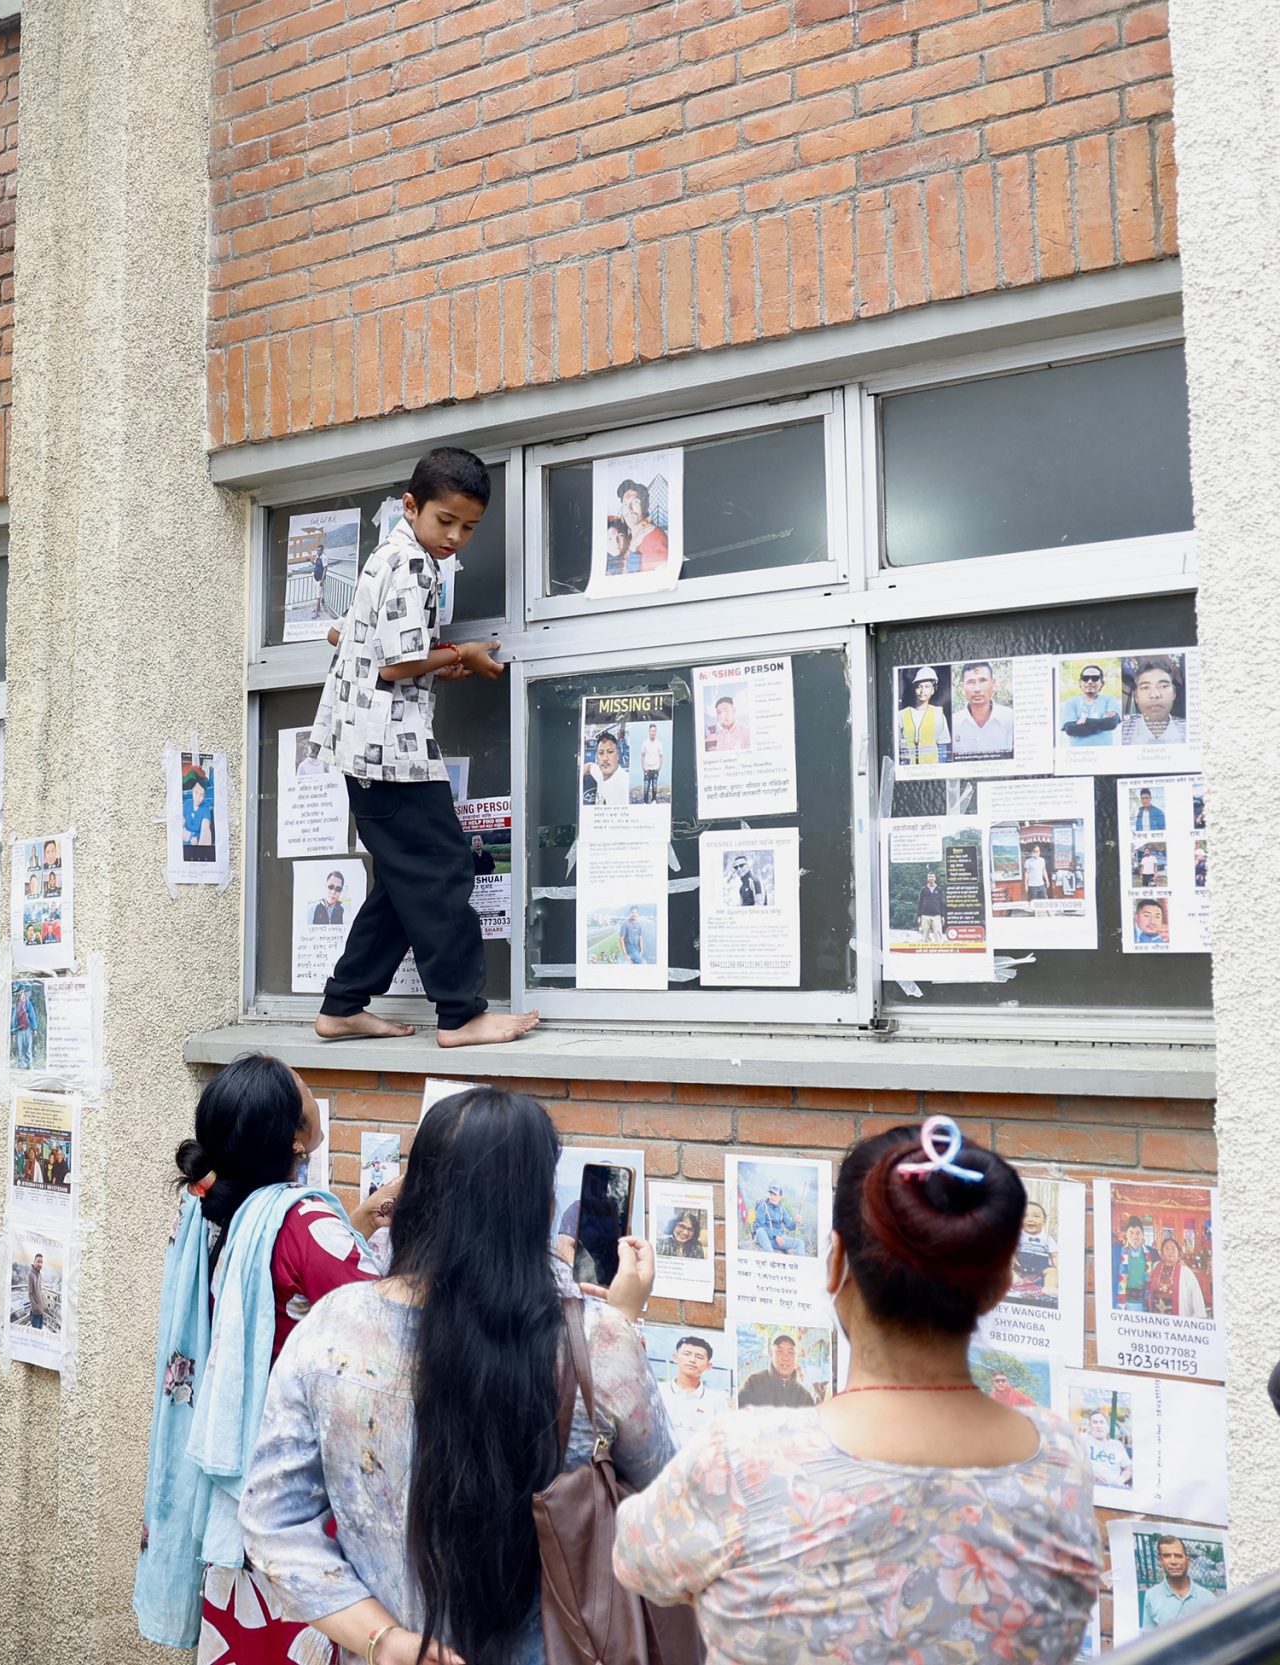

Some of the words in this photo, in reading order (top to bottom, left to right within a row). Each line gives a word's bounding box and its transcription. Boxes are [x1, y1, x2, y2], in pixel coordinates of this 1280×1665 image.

[699, 667, 741, 681] MSSING
[744, 662, 784, 675] PERSON
[599, 697, 651, 714] MISSING
[654, 696, 663, 711] !!
[454, 802, 474, 815] SSING
[477, 801, 512, 812] PERSO
[476, 875, 503, 884] SHUAI
[480, 917, 511, 926] 4773033
[1011, 1306, 1062, 1321] WANGCHU
[1110, 1312, 1170, 1327] GYALSHANG
[1172, 1319, 1216, 1332] WANGDI
[994, 1317, 1046, 1332] SHYANGBA
[989, 1330, 1051, 1348] 9810077082
[1117, 1327, 1161, 1340] CHYUNKI
[1164, 1331, 1210, 1345] TAMANG
[1130, 1342, 1197, 1359] 9810077082
[1117, 1352, 1199, 1375] 9703641159
[1090, 1446, 1116, 1465] Lee
